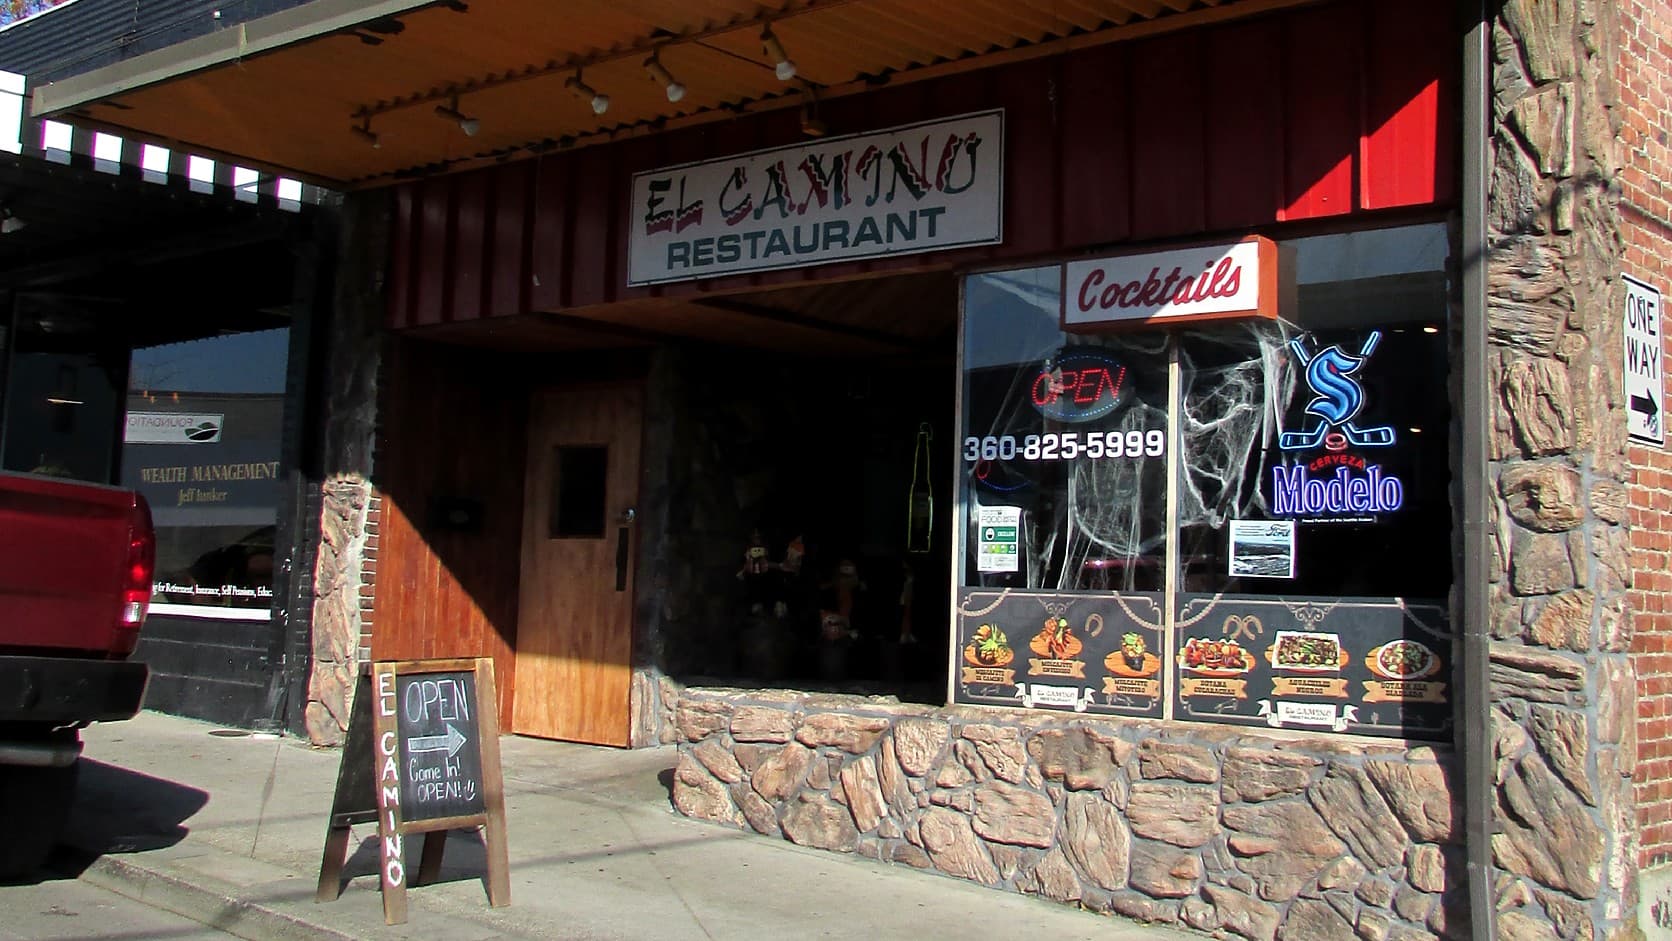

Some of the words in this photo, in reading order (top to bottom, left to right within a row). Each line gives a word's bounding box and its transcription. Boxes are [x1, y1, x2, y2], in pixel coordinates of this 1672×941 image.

[644, 177, 703, 236] EL
[718, 131, 983, 227] CAMINO
[666, 205, 947, 271] RESTAURANT
[1077, 256, 1243, 313] Cocktails
[1627, 292, 1656, 337] ONE
[1626, 335, 1659, 380] WAY
[1031, 366, 1127, 406] OPEN
[963, 429, 1165, 462] 360-825-5999
[1309, 454, 1366, 472] CERVEZA
[140, 467, 188, 484] WEALTH
[191, 461, 281, 482] MANAGEMENT
[1273, 464, 1403, 515] Modelo
[176, 488, 197, 507] Jeff
[1265, 523, 1291, 537] Ford
[379, 672, 395, 717] EL
[405, 679, 470, 723] OPEN
[408, 758, 442, 782] Come
[445, 757, 462, 778] In!
[380, 731, 404, 887] CAMINO
[417, 781, 462, 803] OPEN!
